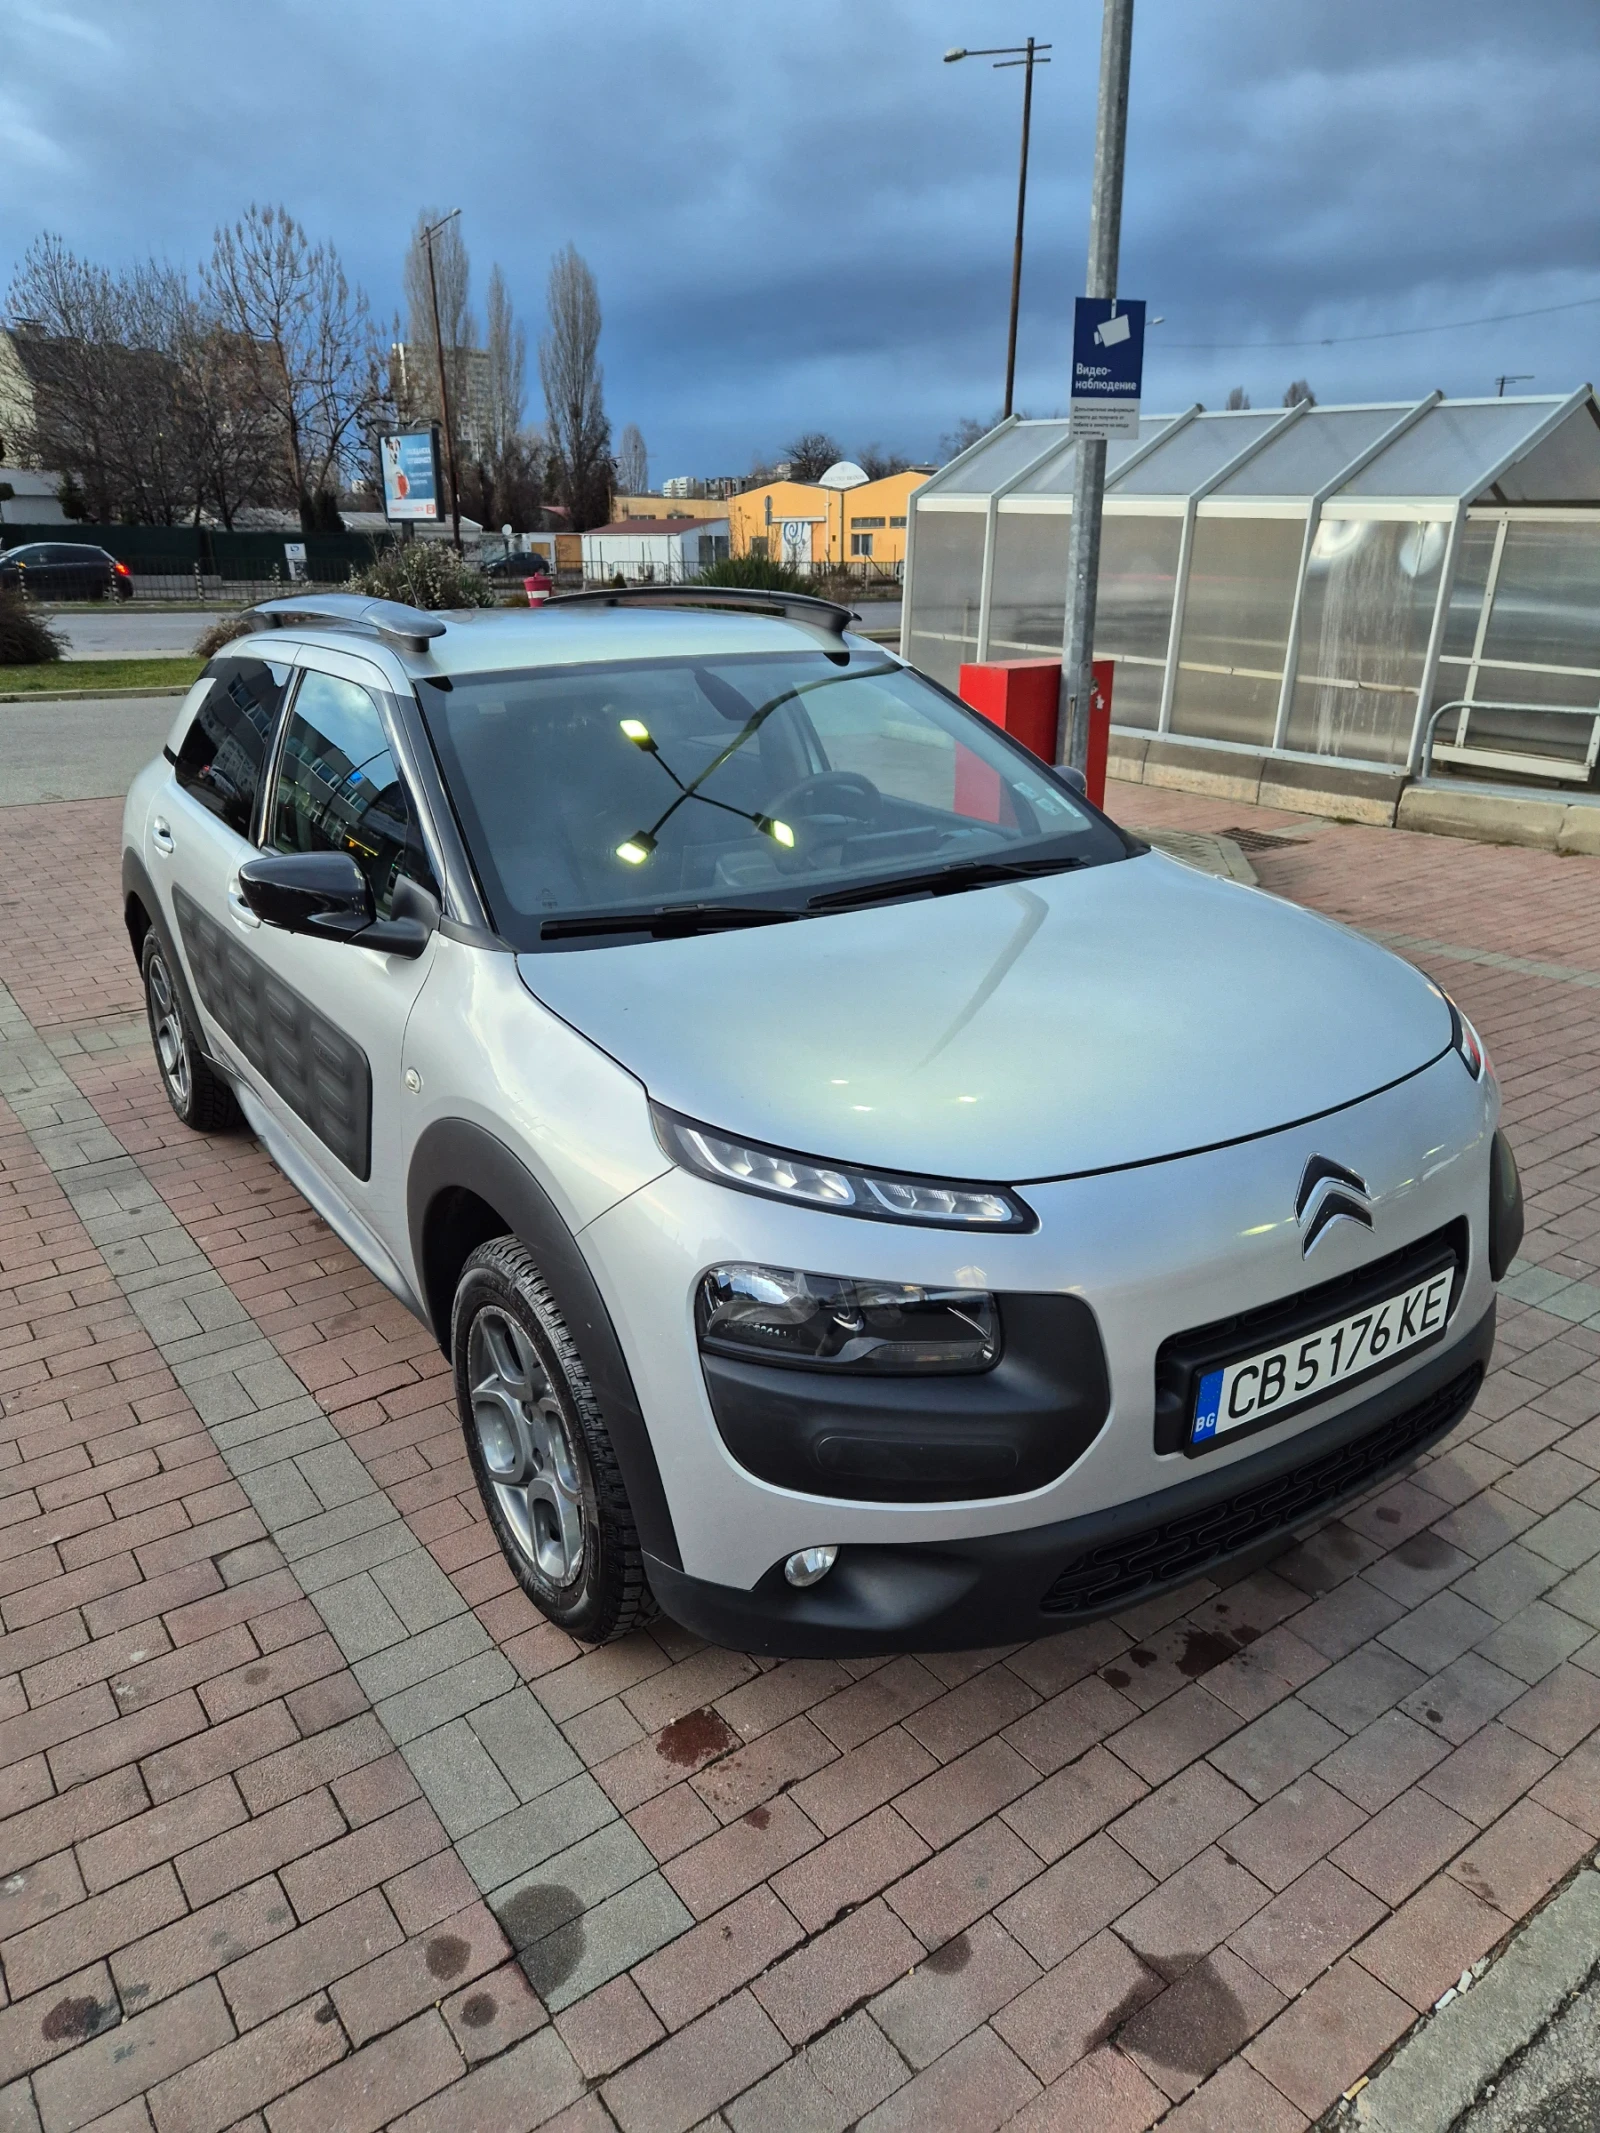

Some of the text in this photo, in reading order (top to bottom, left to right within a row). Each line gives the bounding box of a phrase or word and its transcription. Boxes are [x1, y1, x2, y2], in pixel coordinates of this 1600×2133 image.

[1076, 362, 1112, 377] Видео-
[1075, 378, 1137, 392] наблюдение
[1294, 1306, 1391, 1392] 5176
[1195, 1412, 1215, 1432] BG
